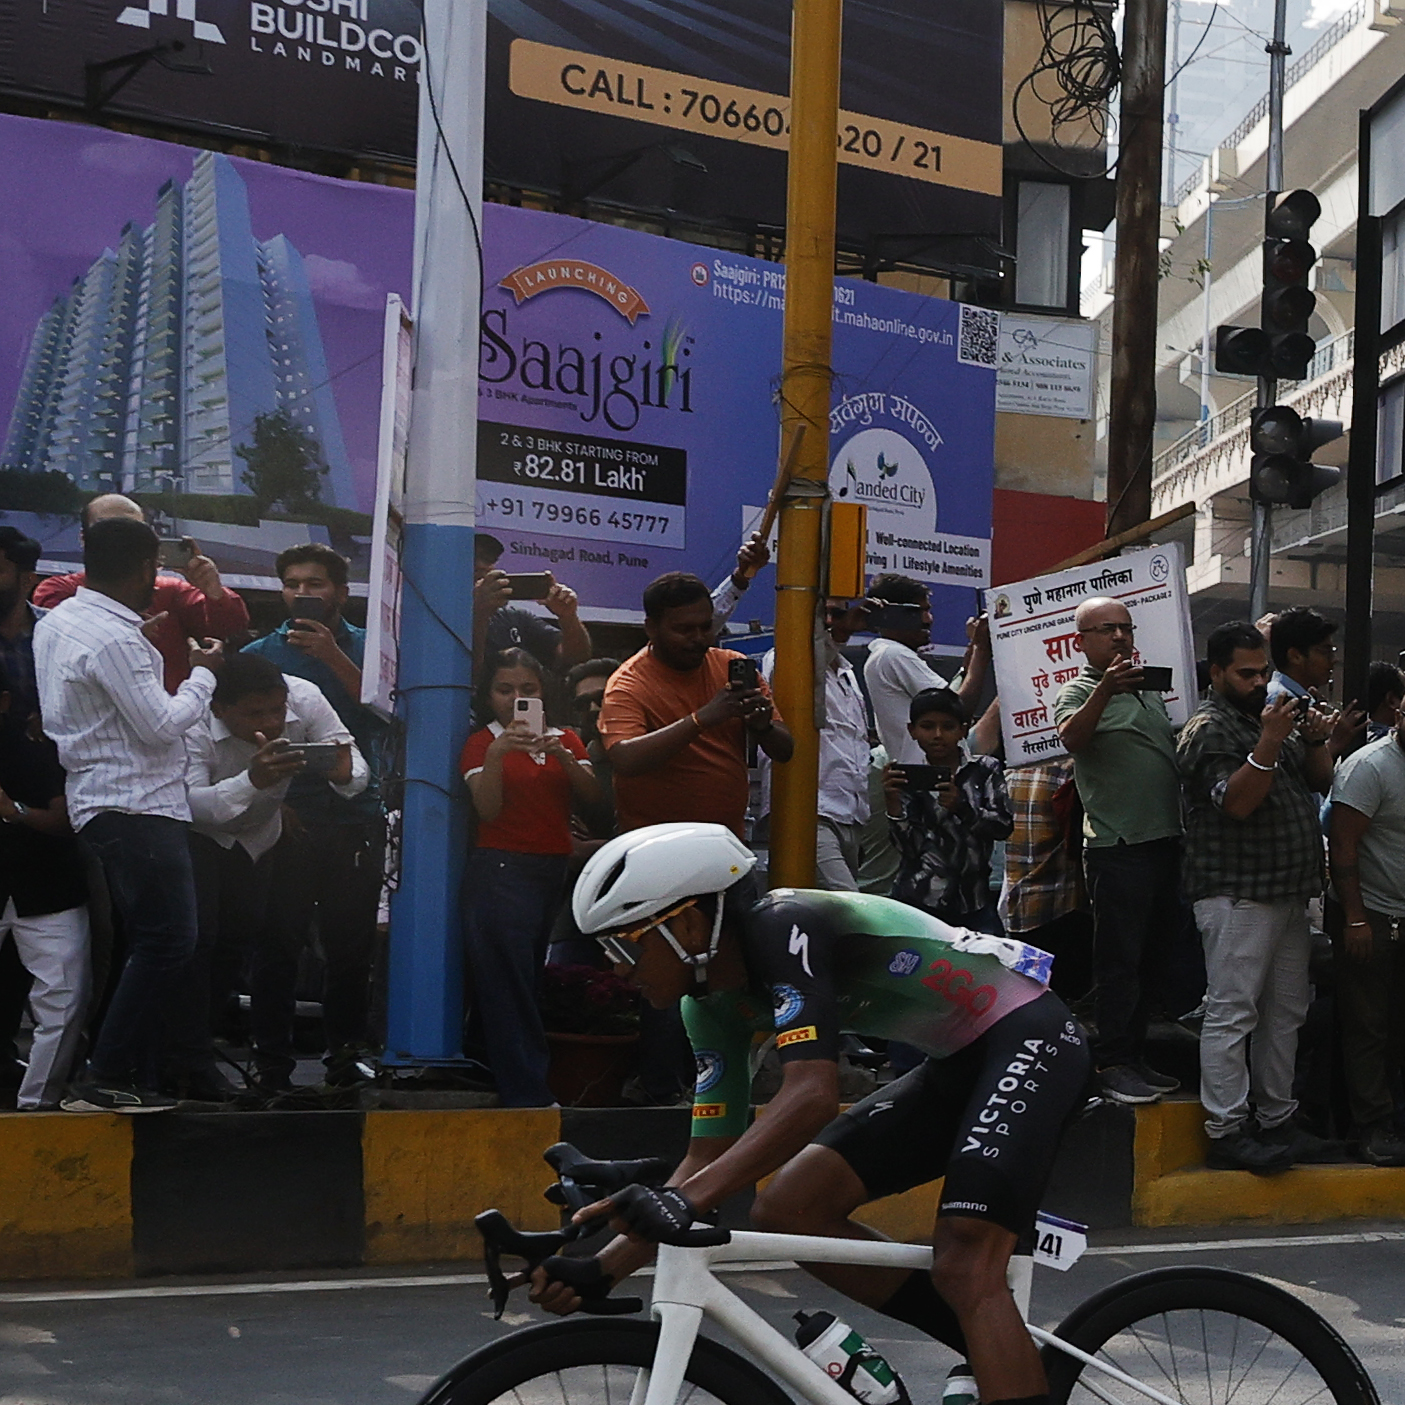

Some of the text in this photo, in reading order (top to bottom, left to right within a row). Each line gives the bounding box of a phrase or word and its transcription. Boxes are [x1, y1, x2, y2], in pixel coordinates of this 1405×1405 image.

[251, 37, 421, 84] LANDMAR
[560, 63, 655, 111] CALL
[913, 141, 943, 173] 21
[524, 266, 629, 304] LAUNCHING
[478, 308, 694, 432] Saajgiri
[1022, 353, 1087, 370] Associates
[890, 395, 945, 453] संपन्न
[500, 432, 660, 467] 2 & 3 BHK STARTING FROM
[899, 484, 926, 508] City
[486, 497, 670, 535] +91 79966 45777
[509, 540, 649, 569] Sinhagad Road, Pune
[875, 531, 980, 558] Well-connected Location
[902, 556, 941, 576] Lifestyle
[941, 561, 984, 579] Amenities
[1022, 568, 1134, 614] पुणे महानगर पालिका
[1030, 667, 1051, 697] पुढे
[1011, 699, 1049, 730] वाहने
[920, 958, 998, 1017] 2GO
[960, 1038, 1045, 1153] VICTORIA
[982, 1043, 1059, 1159] SPORTS
